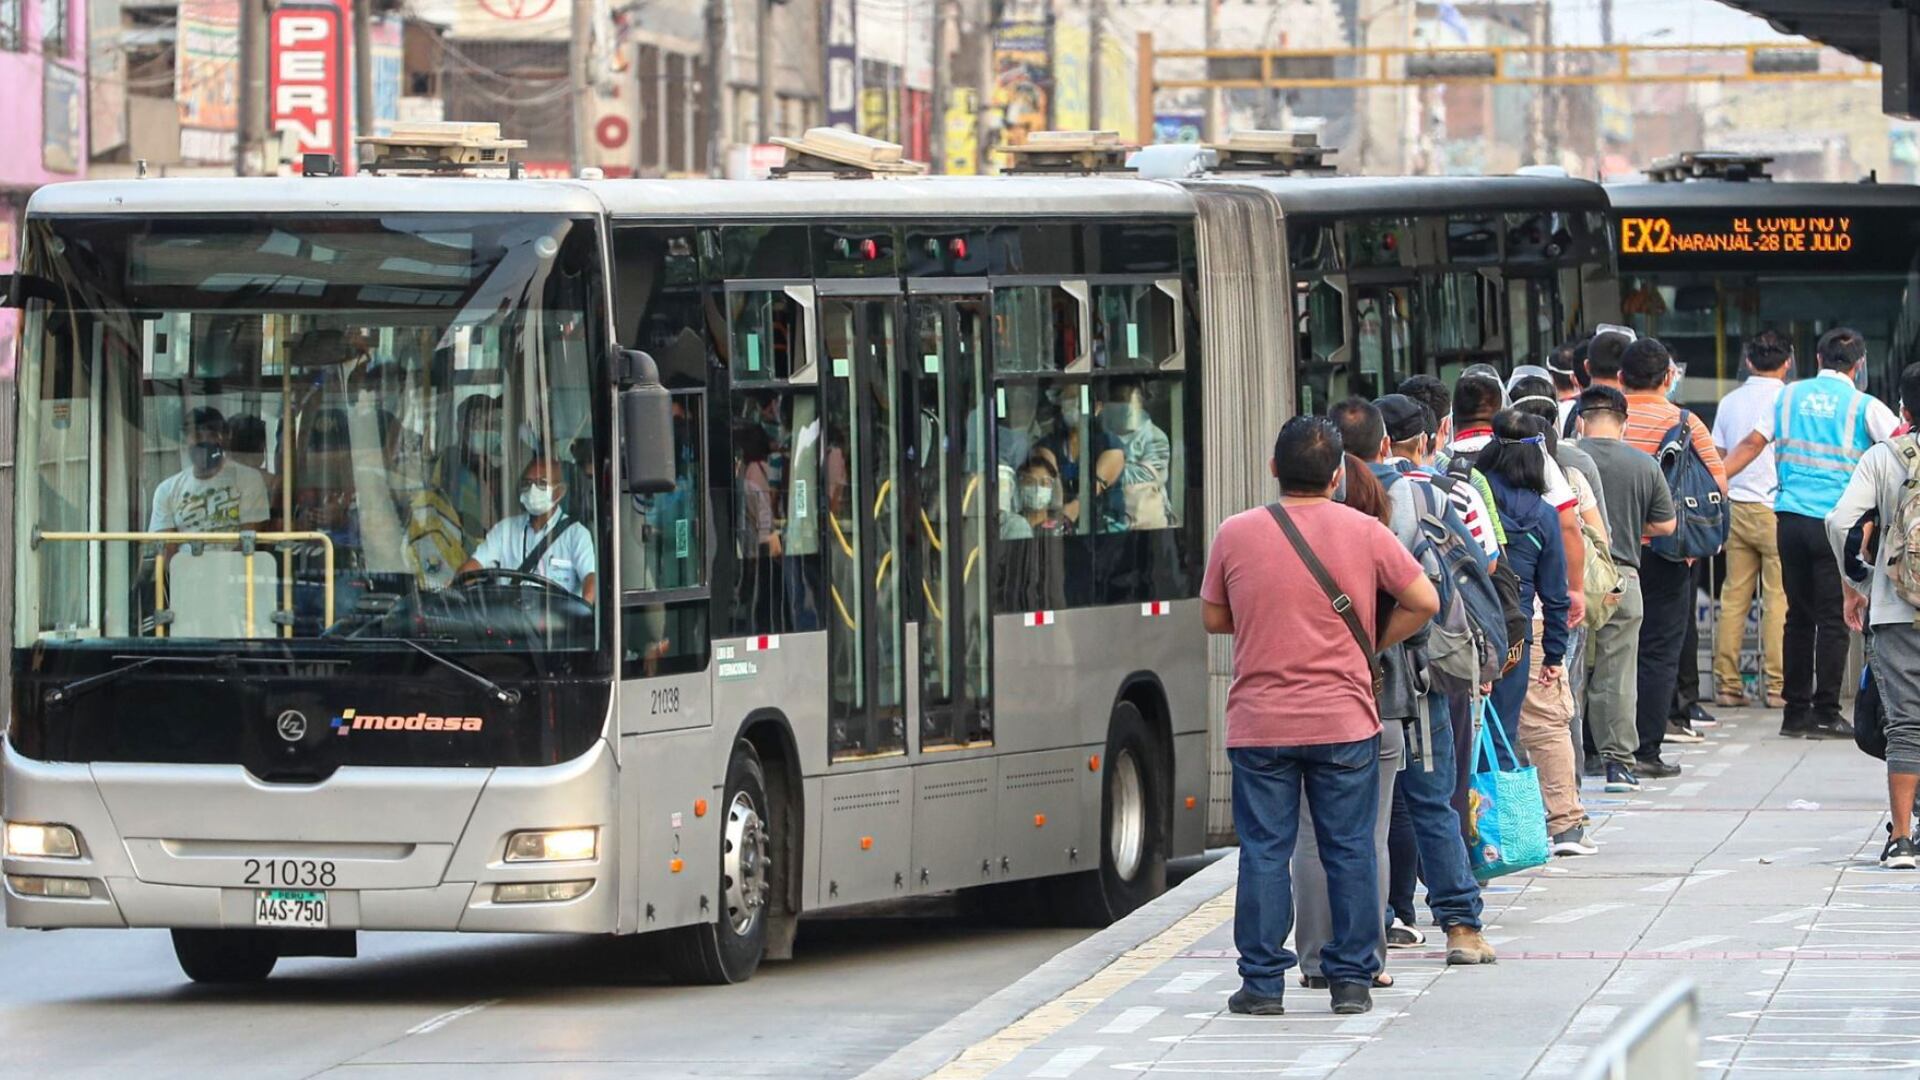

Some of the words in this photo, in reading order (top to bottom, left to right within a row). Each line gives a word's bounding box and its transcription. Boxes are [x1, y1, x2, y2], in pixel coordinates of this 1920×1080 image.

[1621, 218, 1671, 253] EX2
[1784, 233, 1805, 251] DE
[1810, 233, 1850, 251] JULIO
[651, 686, 680, 715] 21038
[352, 712, 483, 732] modasa
[243, 858, 336, 887] 21038
[258, 899, 324, 922] A4S-750
